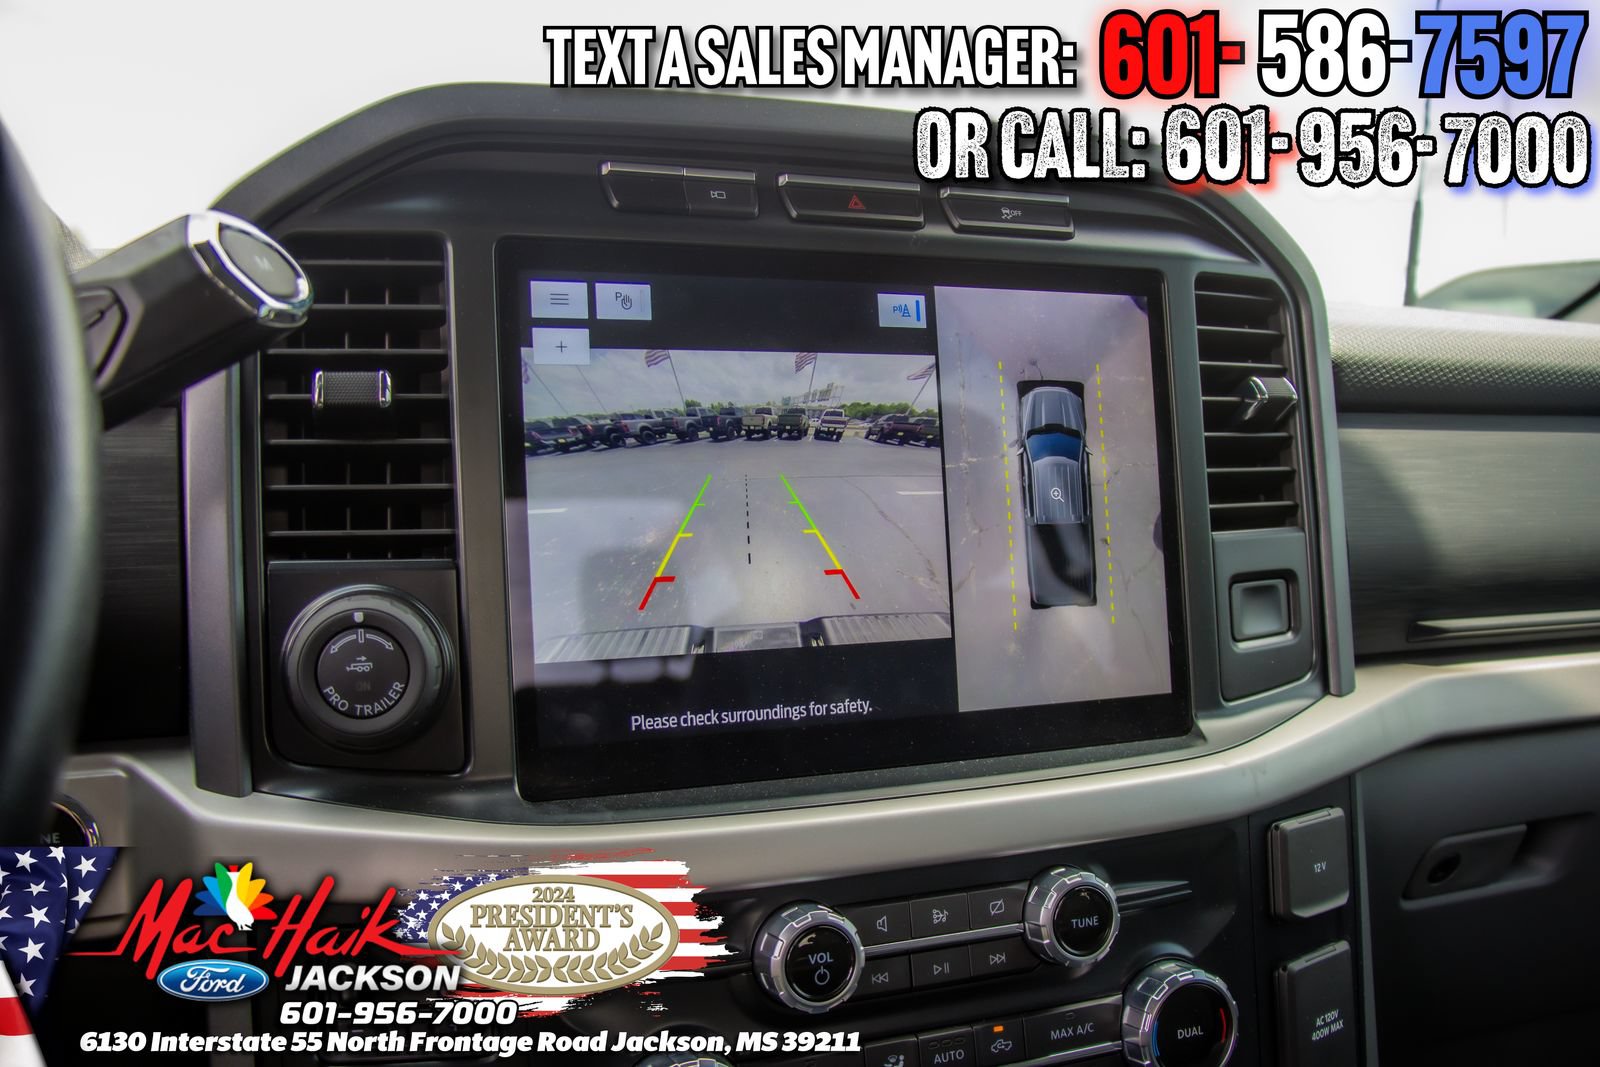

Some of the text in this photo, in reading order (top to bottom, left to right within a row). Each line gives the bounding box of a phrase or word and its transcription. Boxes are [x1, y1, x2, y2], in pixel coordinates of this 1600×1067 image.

[323, 681, 406, 717] PRO TRAILER
[631, 699, 873, 731] Please check surroundings for safety.
[1071, 915, 1100, 929] TUNE
[808, 953, 834, 965] VOL
[1315, 1009, 1339, 1028] AC 120V
[1050, 1022, 1095, 1041] MAX A/C
[1176, 1026, 1204, 1040] DUAL
[1311, 1019, 1344, 1041] 400W MAX
[933, 1047, 966, 1064] AUTO
